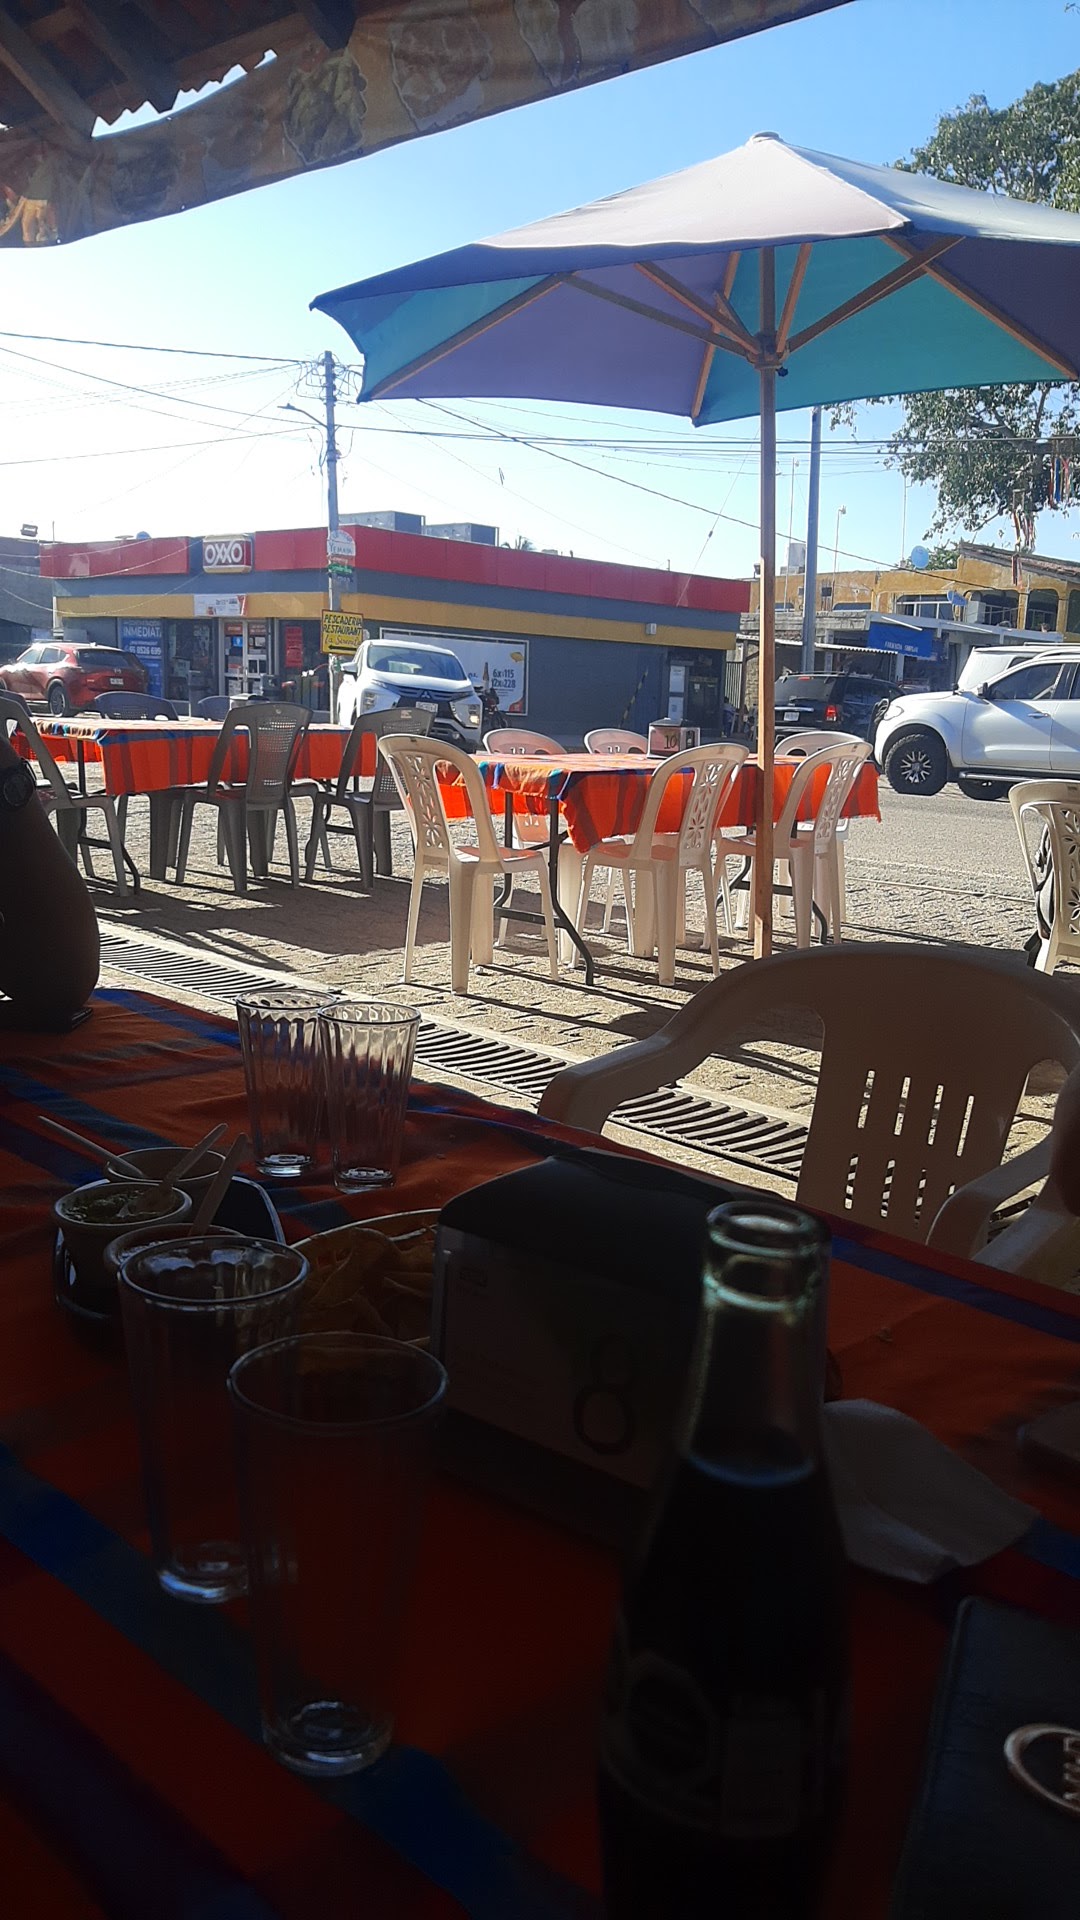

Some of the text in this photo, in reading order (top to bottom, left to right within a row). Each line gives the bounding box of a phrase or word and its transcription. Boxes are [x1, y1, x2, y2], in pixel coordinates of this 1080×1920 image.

[205, 541, 243, 565] OXXO
[323, 624, 361, 636] RESTAURANT
[664, 735, 678, 749] 10
[573, 1332, 635, 1457] 8
